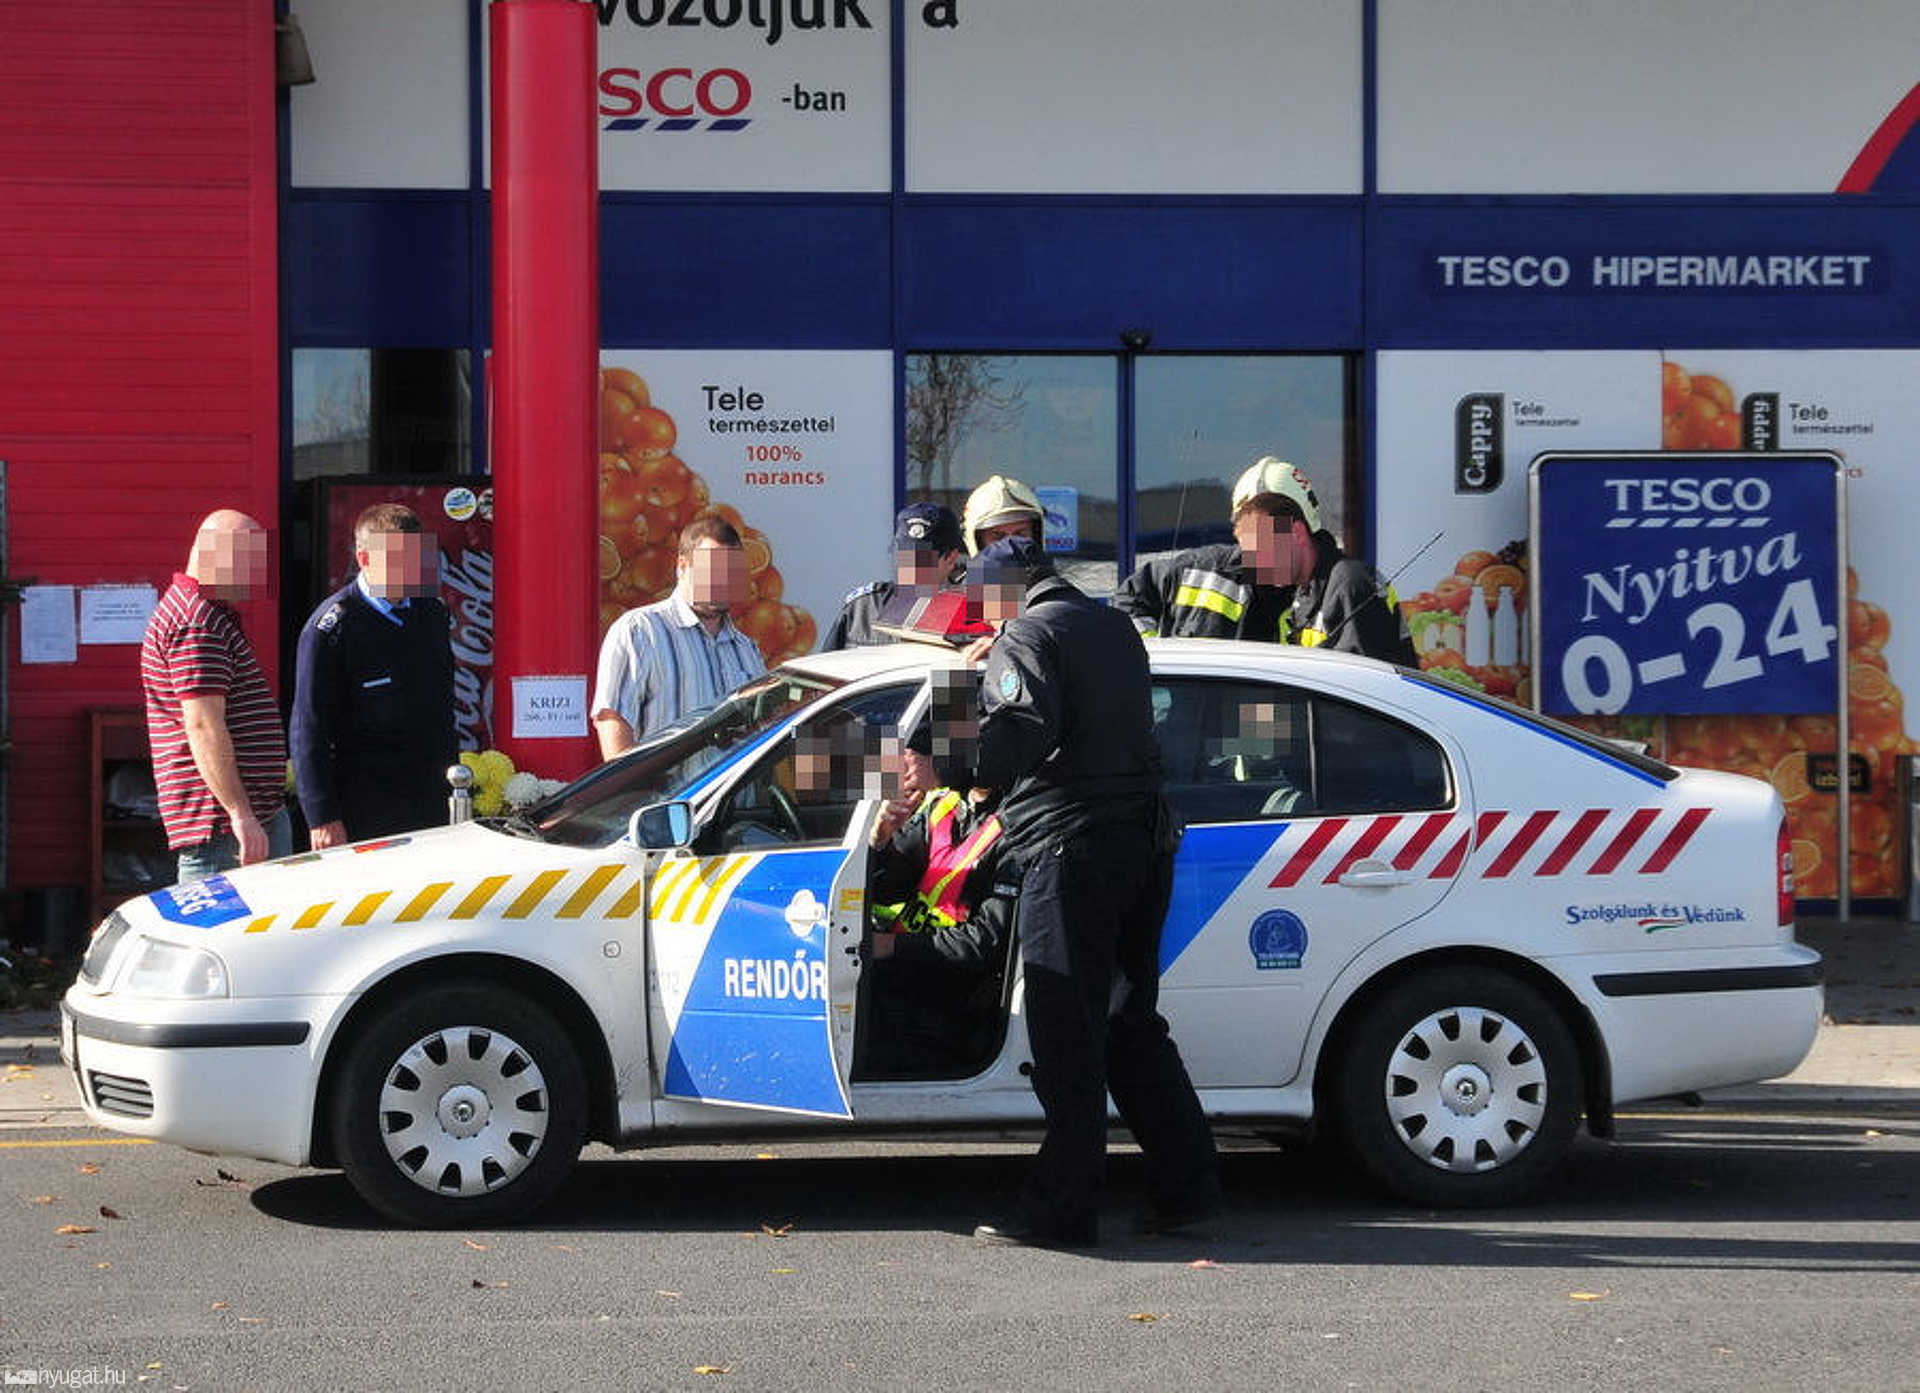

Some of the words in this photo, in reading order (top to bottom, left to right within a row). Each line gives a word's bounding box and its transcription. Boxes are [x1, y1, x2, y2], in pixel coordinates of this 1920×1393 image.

[922, 0, 959, 28] a
[782, 83, 846, 111] -ban
[1438, 256, 1569, 286] TESCO
[1593, 256, 1870, 286] HIPERMARKET
[702, 386, 764, 411] Tele
[1789, 403, 1828, 420] Tele
[709, 416, 835, 433] természettel
[1753, 401, 1770, 450] appy
[746, 445, 802, 461] 100%
[1465, 405, 1493, 486] Cappy
[745, 471, 825, 485] narancs
[1604, 478, 1771, 512] TESCO
[1581, 532, 1801, 624] Nyitva
[1562, 579, 1837, 716] 0-24
[1567, 904, 1657, 925] Szolgálunk
[1661, 902, 1679, 918] és
